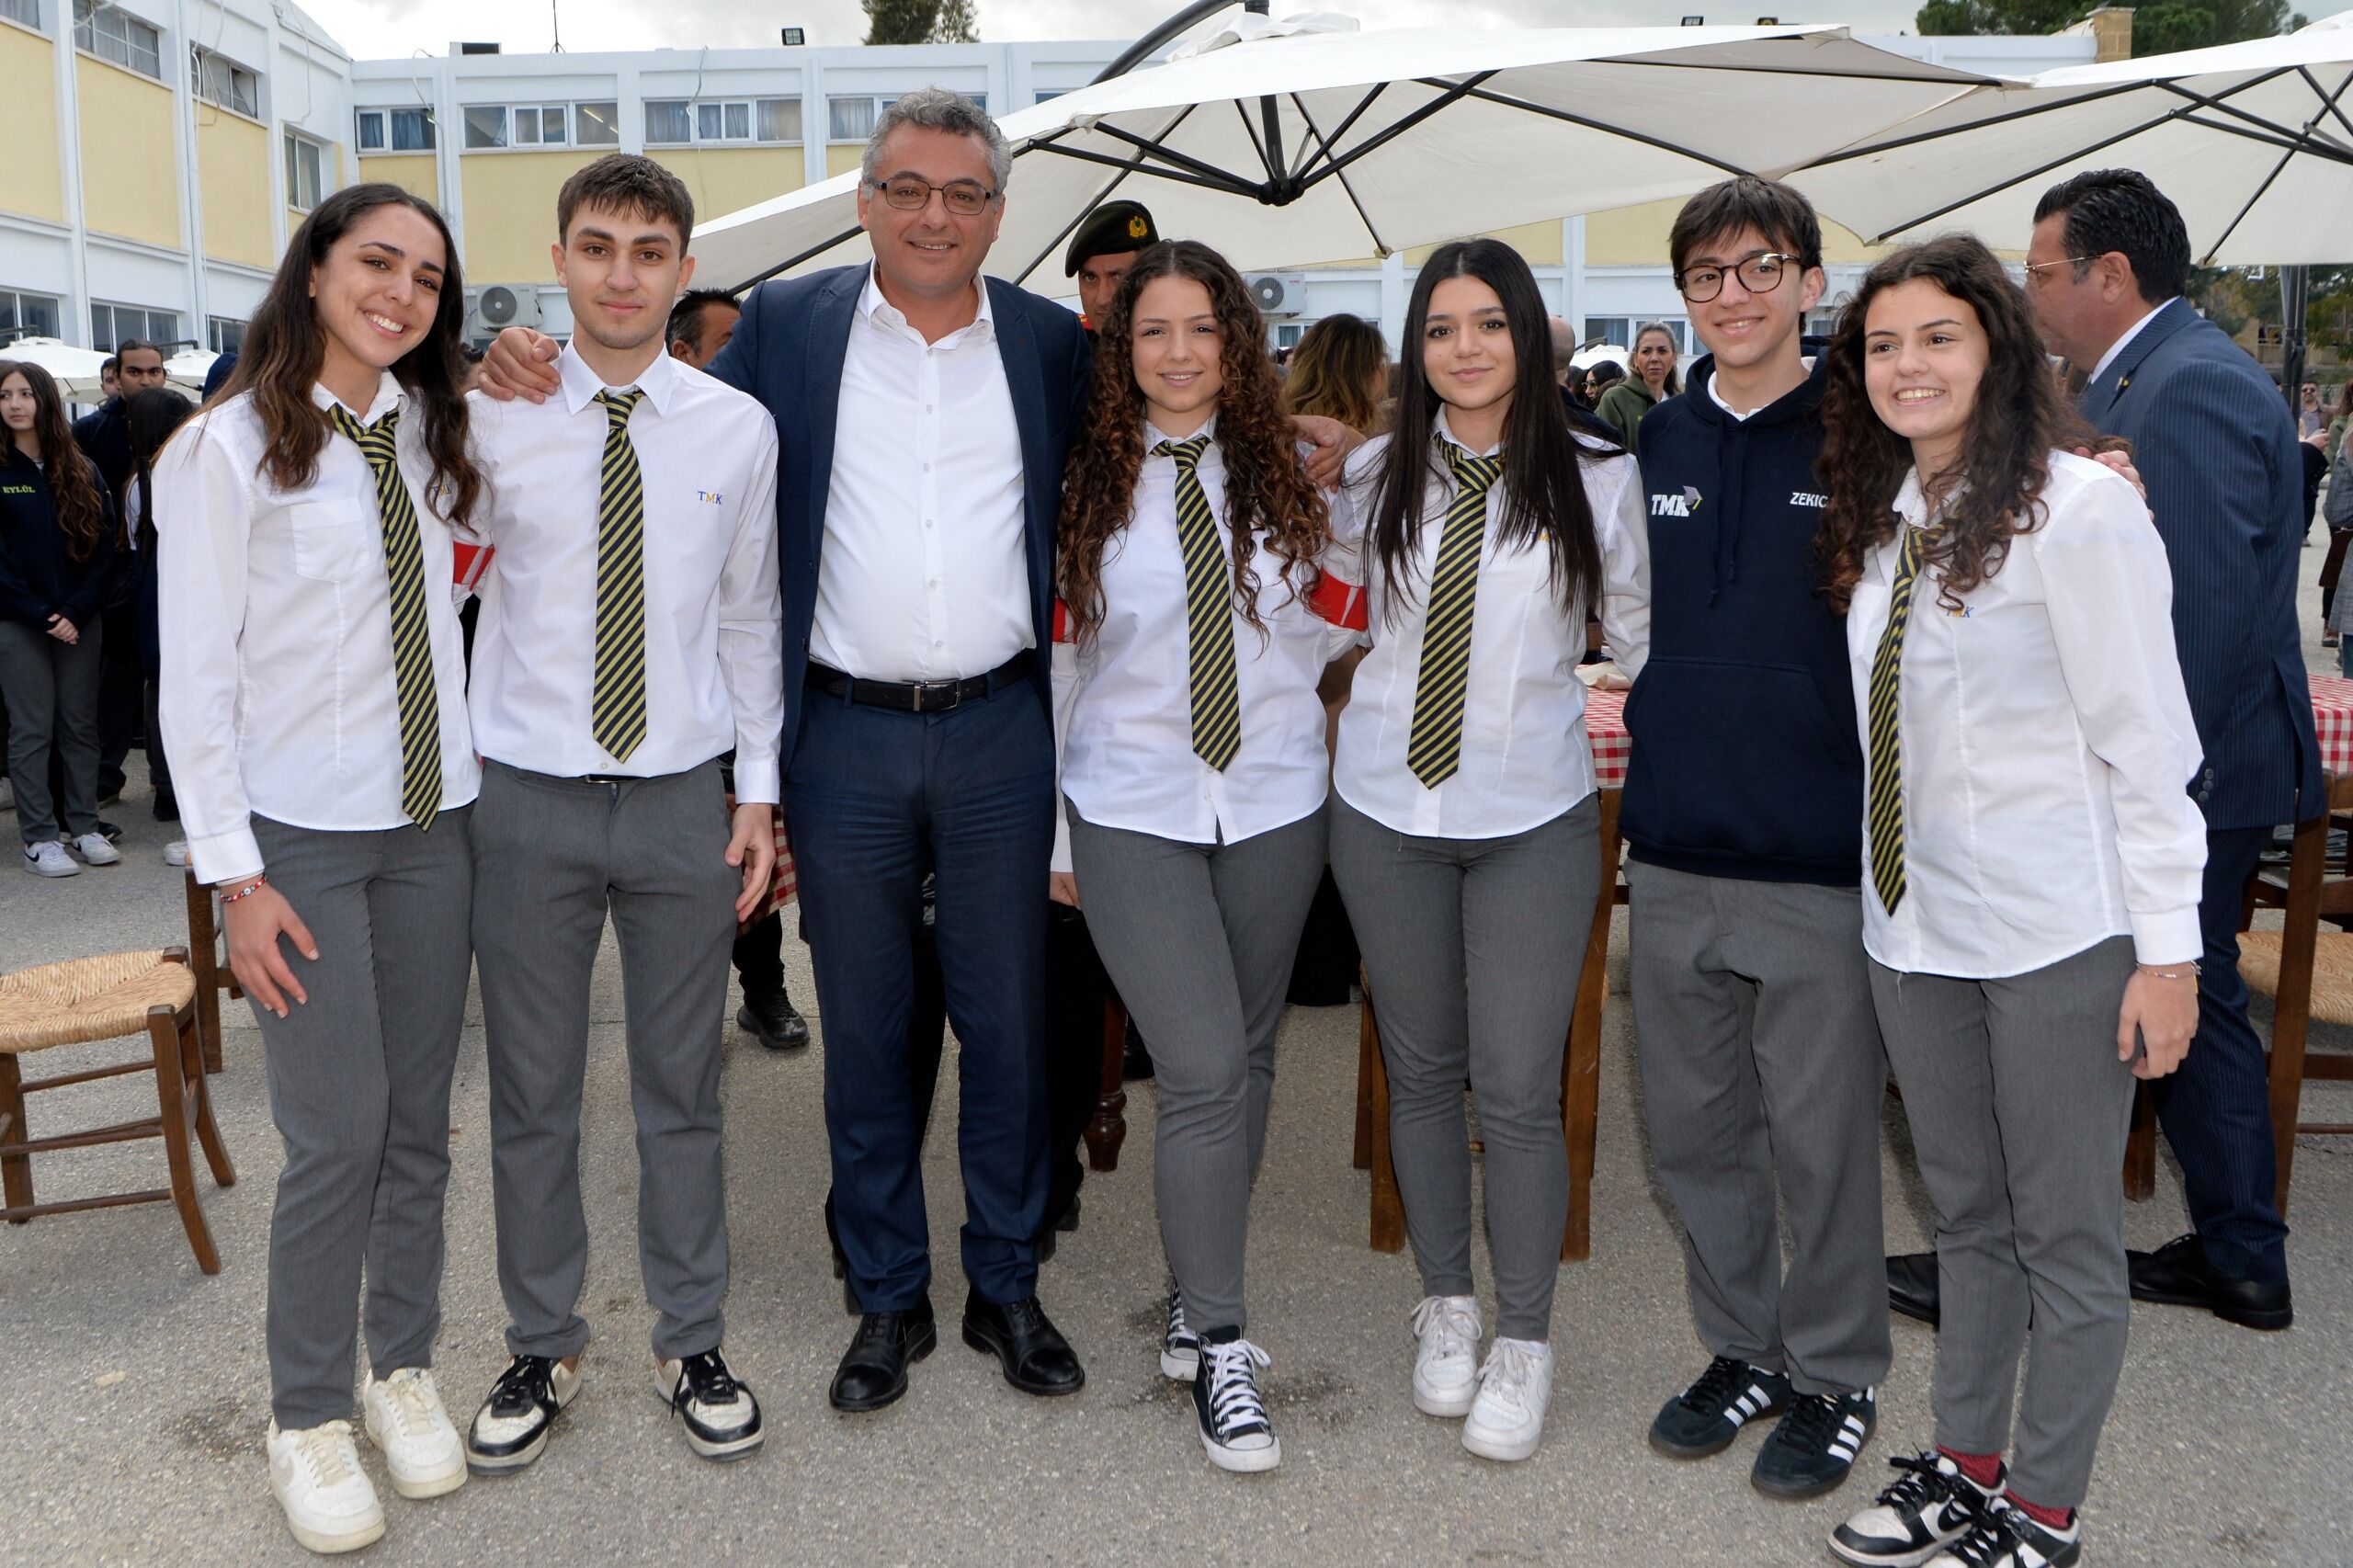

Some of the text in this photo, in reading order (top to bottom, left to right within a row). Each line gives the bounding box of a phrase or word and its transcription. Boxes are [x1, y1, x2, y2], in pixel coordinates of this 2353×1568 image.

[3, 484, 36, 494] EYLÜL
[698, 491, 722, 505] TMK
[1652, 494, 1690, 517] TMK
